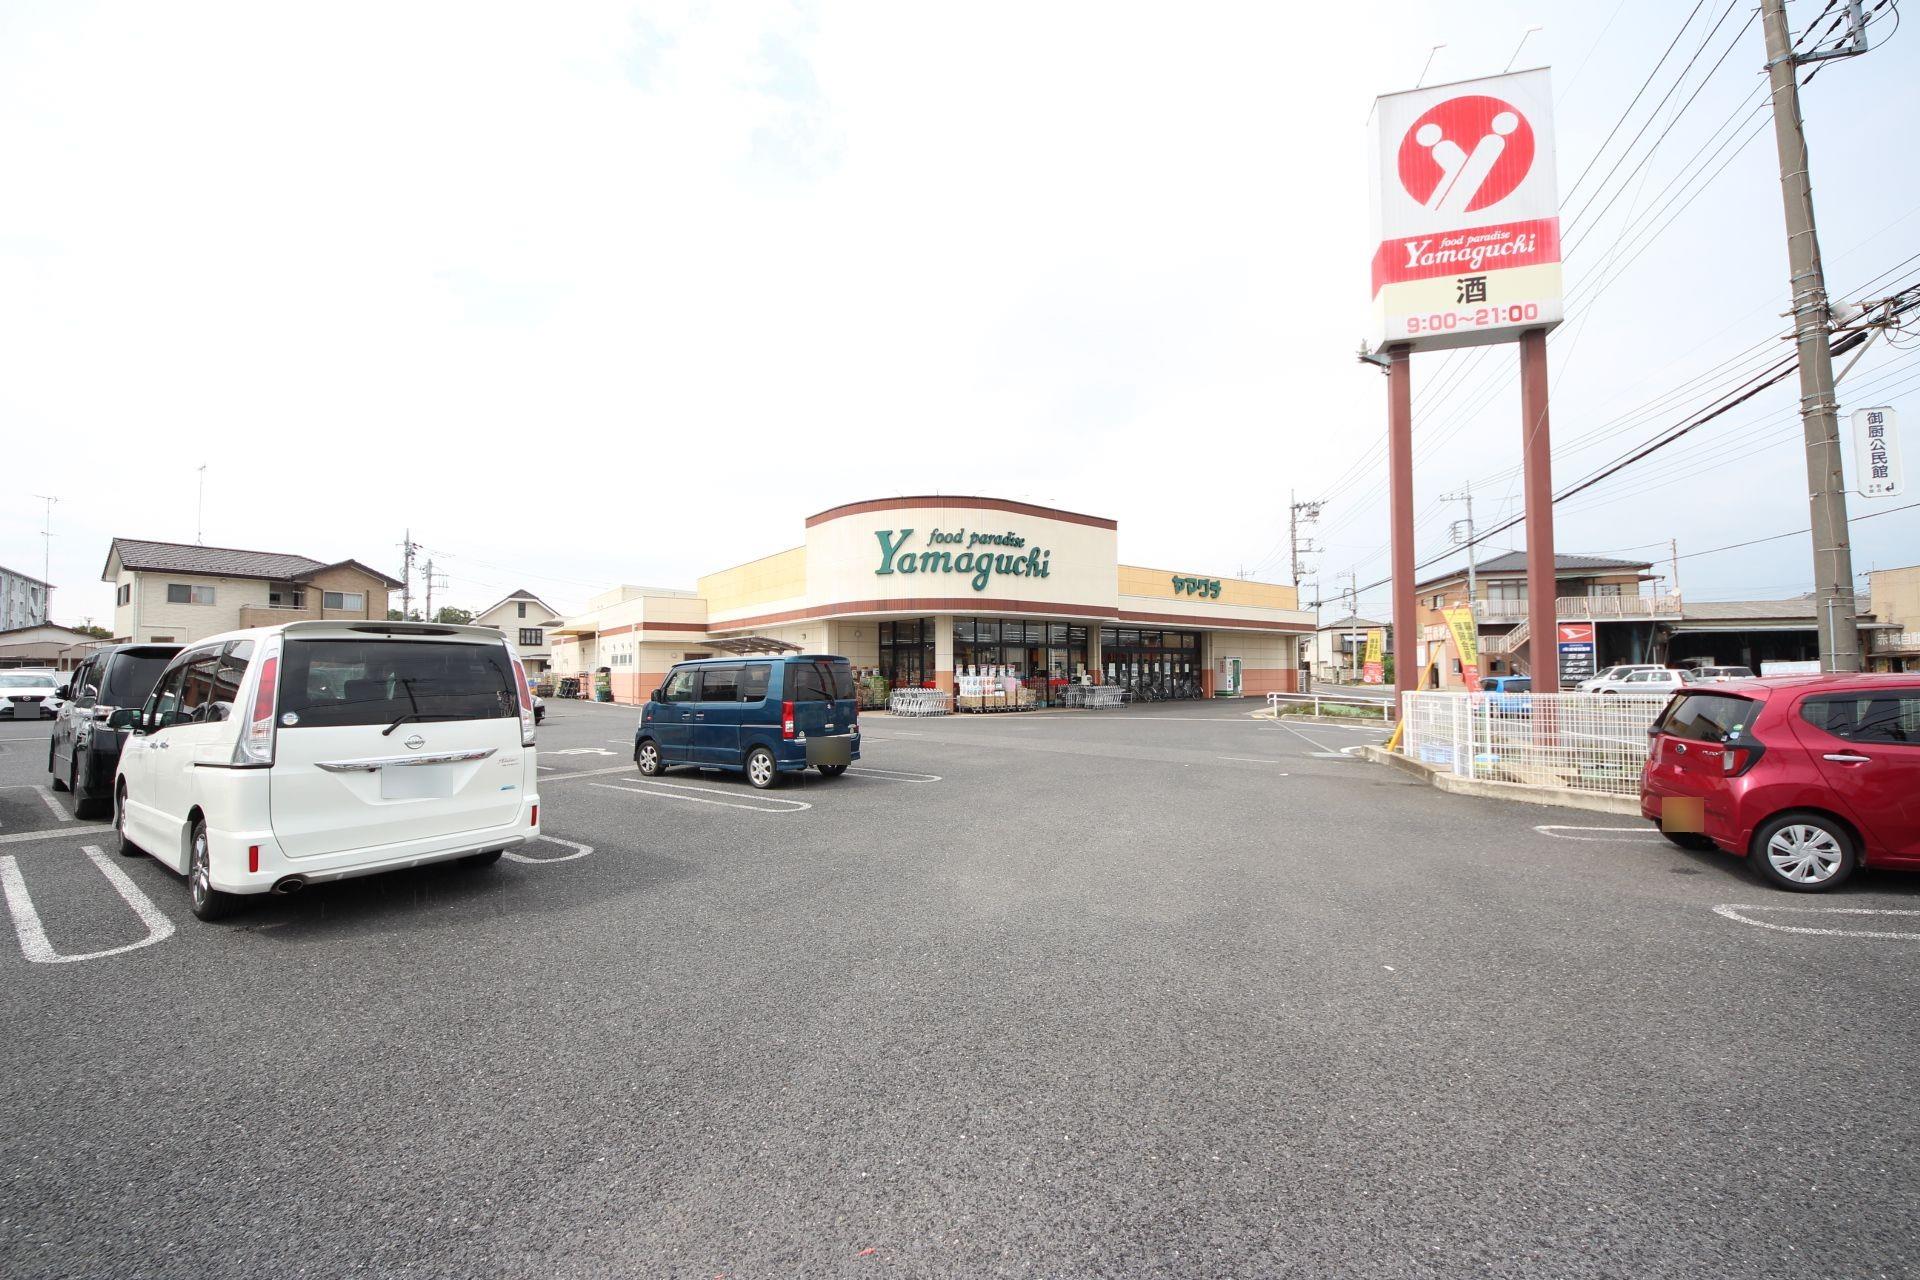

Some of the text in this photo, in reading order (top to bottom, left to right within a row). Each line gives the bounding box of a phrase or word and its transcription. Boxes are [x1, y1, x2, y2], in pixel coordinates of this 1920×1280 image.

[1404, 234, 1536, 270] Yamaguchi
[1440, 231, 1511, 248] food paradise
[1456, 276, 1487, 304] 酒
[1867, 411, 1888, 479] 御厨公民館
[927, 527, 1025, 549] food paradise
[874, 528, 1051, 592] Yamaguchi
